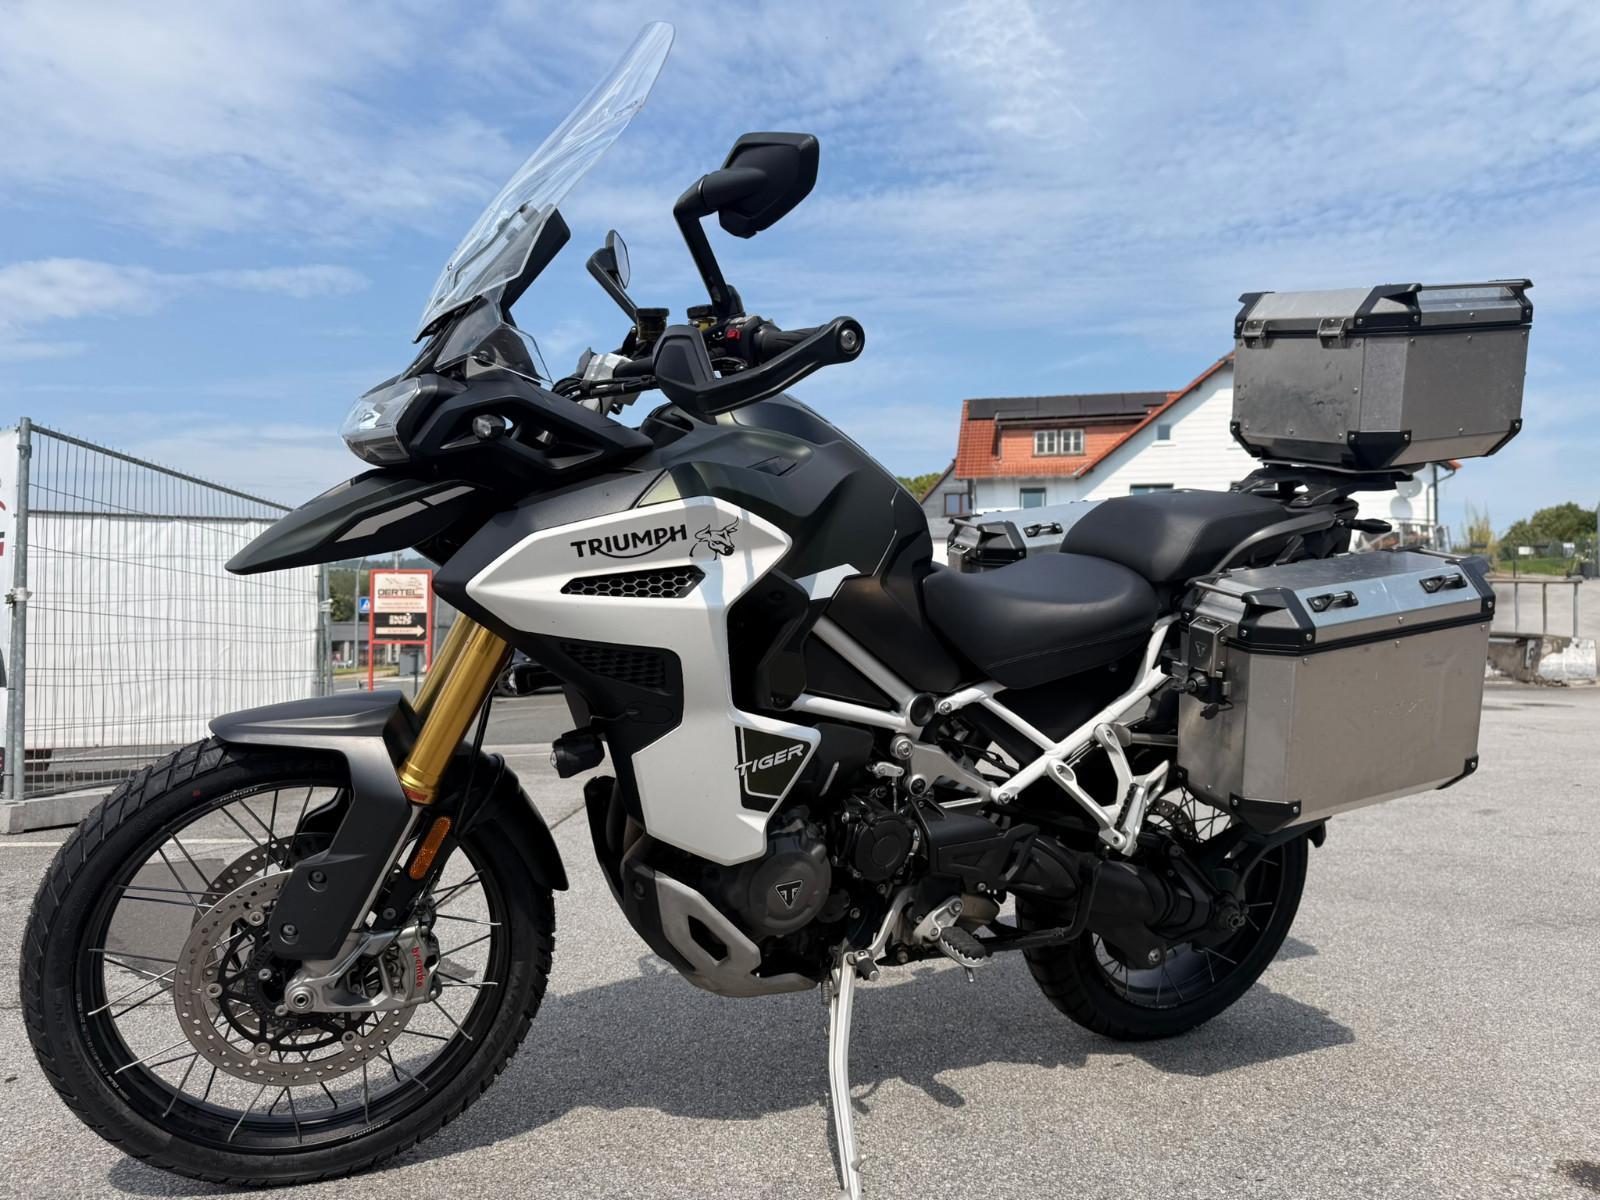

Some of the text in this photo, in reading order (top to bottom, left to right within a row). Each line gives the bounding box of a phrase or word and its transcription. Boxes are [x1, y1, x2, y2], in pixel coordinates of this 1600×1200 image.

[570, 524, 687, 558] TRIUMPH
[377, 588, 416, 596] OERTEL
[735, 743, 804, 776] TIGER
[411, 946, 424, 988] brembo
